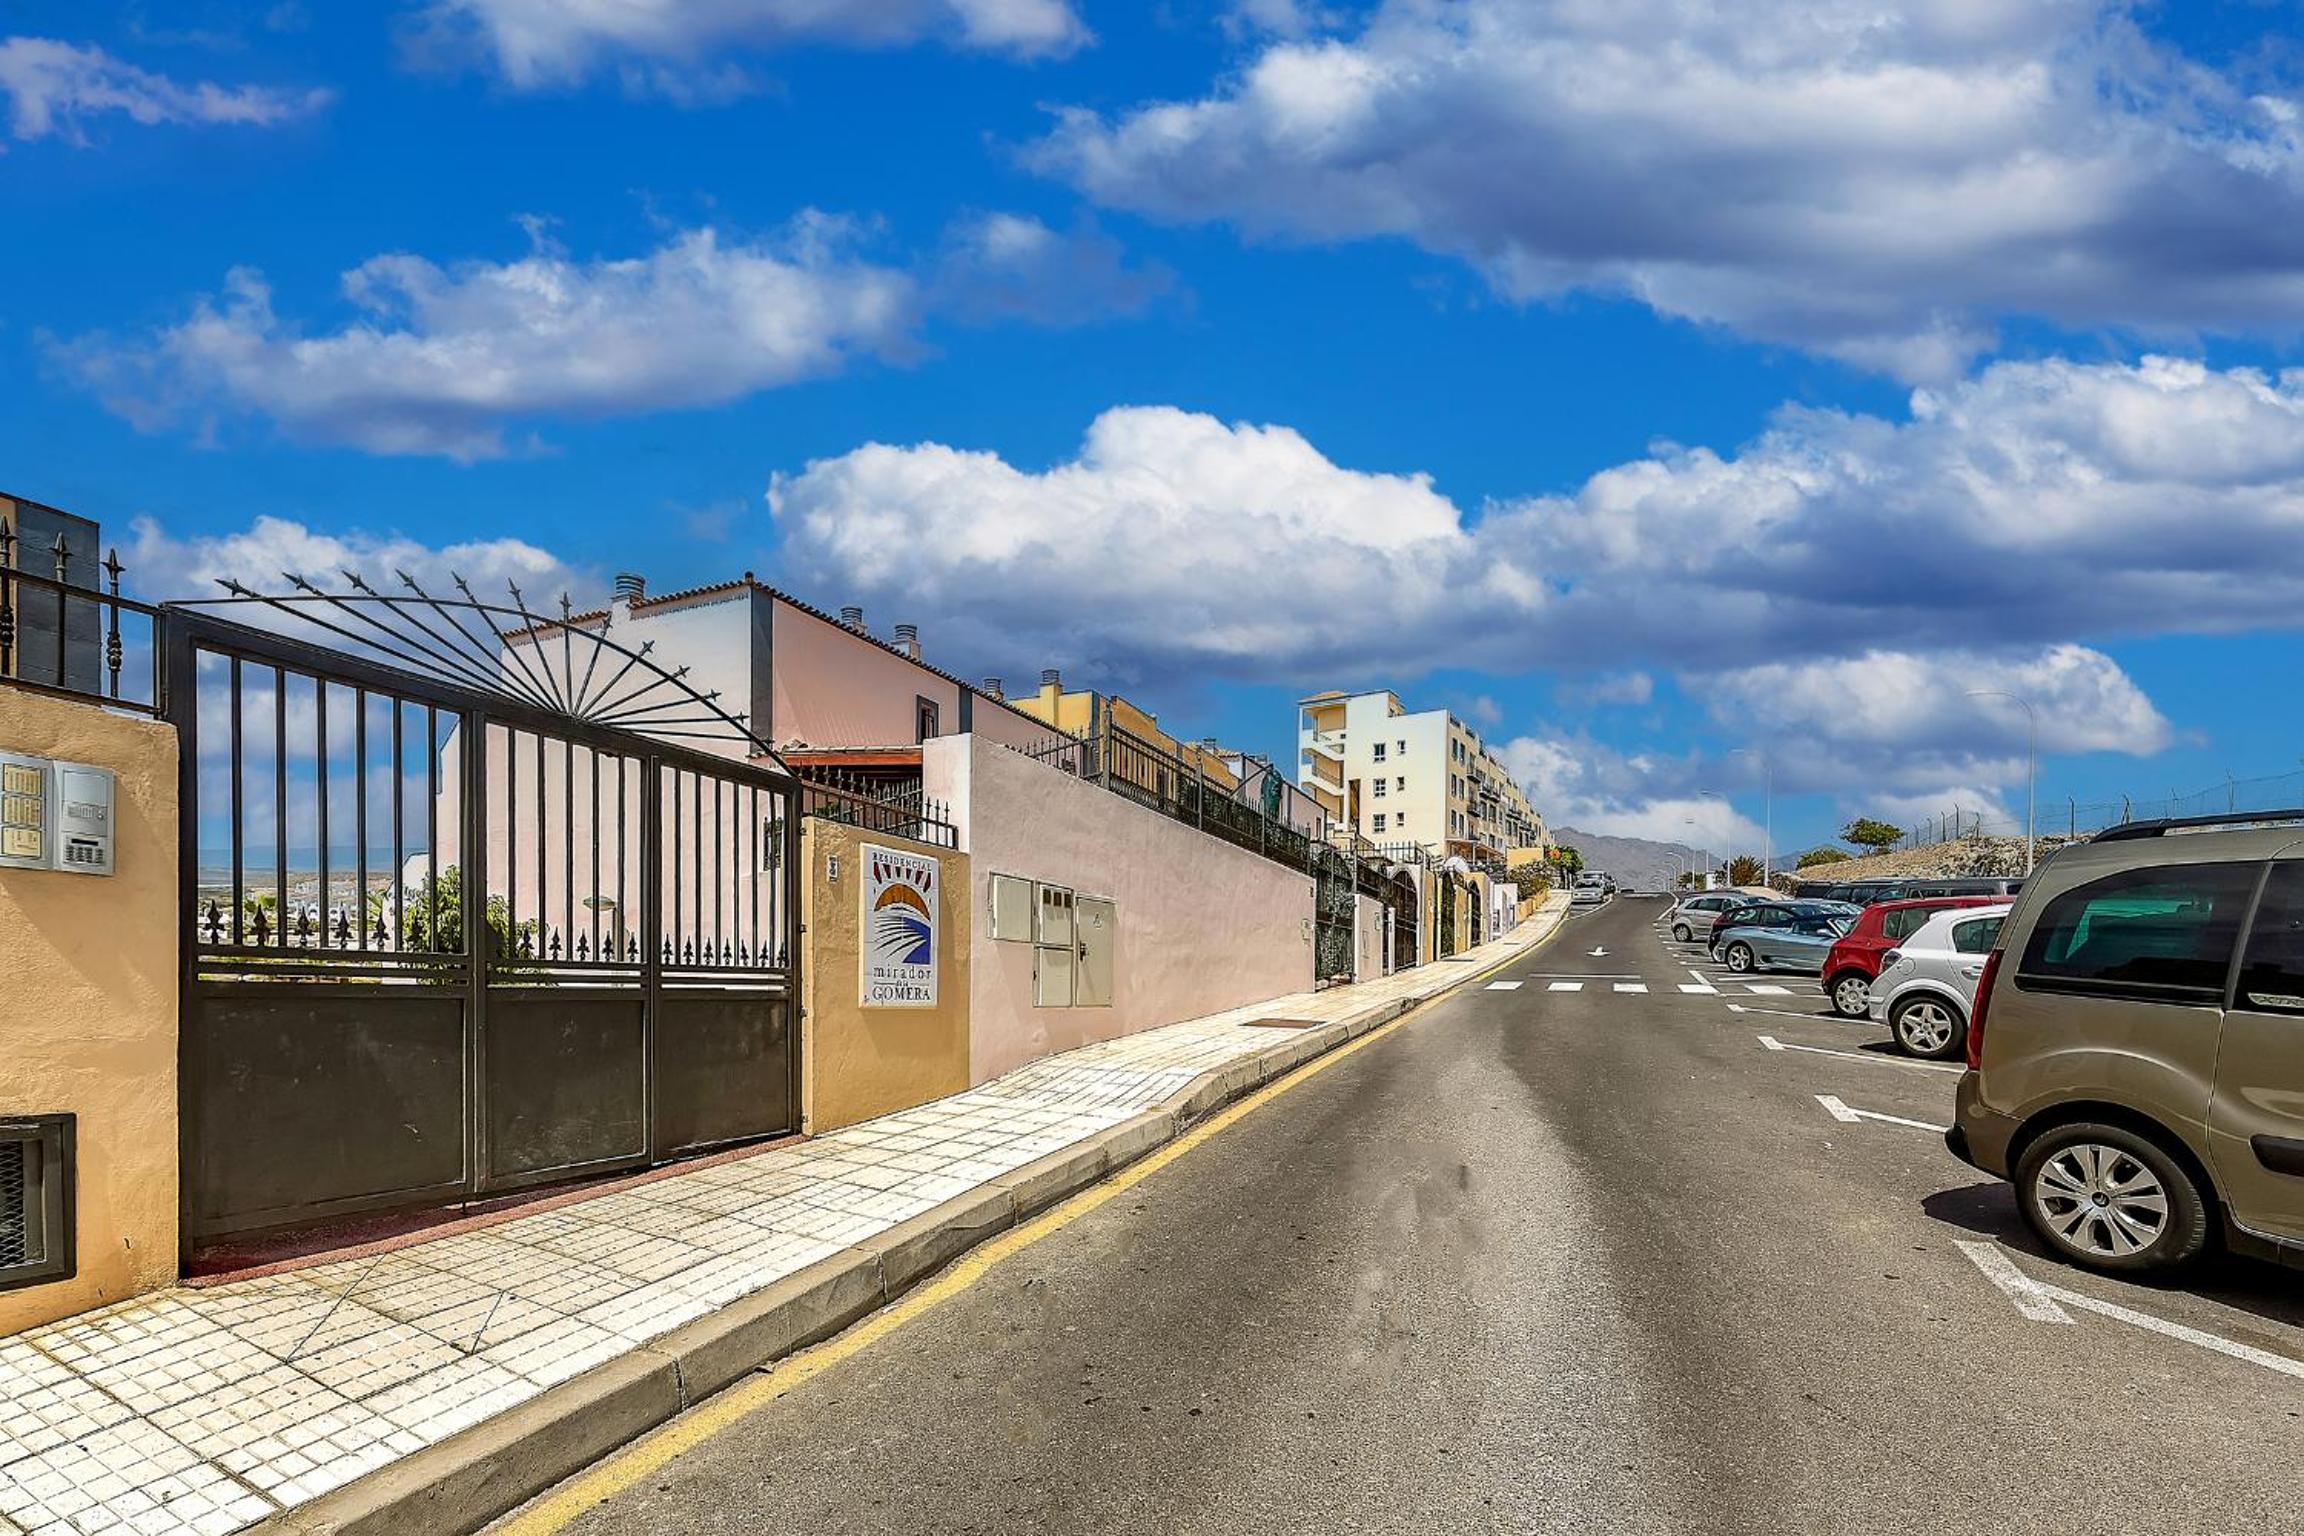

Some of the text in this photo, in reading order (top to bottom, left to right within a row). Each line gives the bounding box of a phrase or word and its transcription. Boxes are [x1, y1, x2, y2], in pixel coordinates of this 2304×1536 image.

[872, 852, 932, 872] RESIDENCIAL
[873, 964, 932, 980] mirador
[872, 985, 931, 1001] GOMERA
